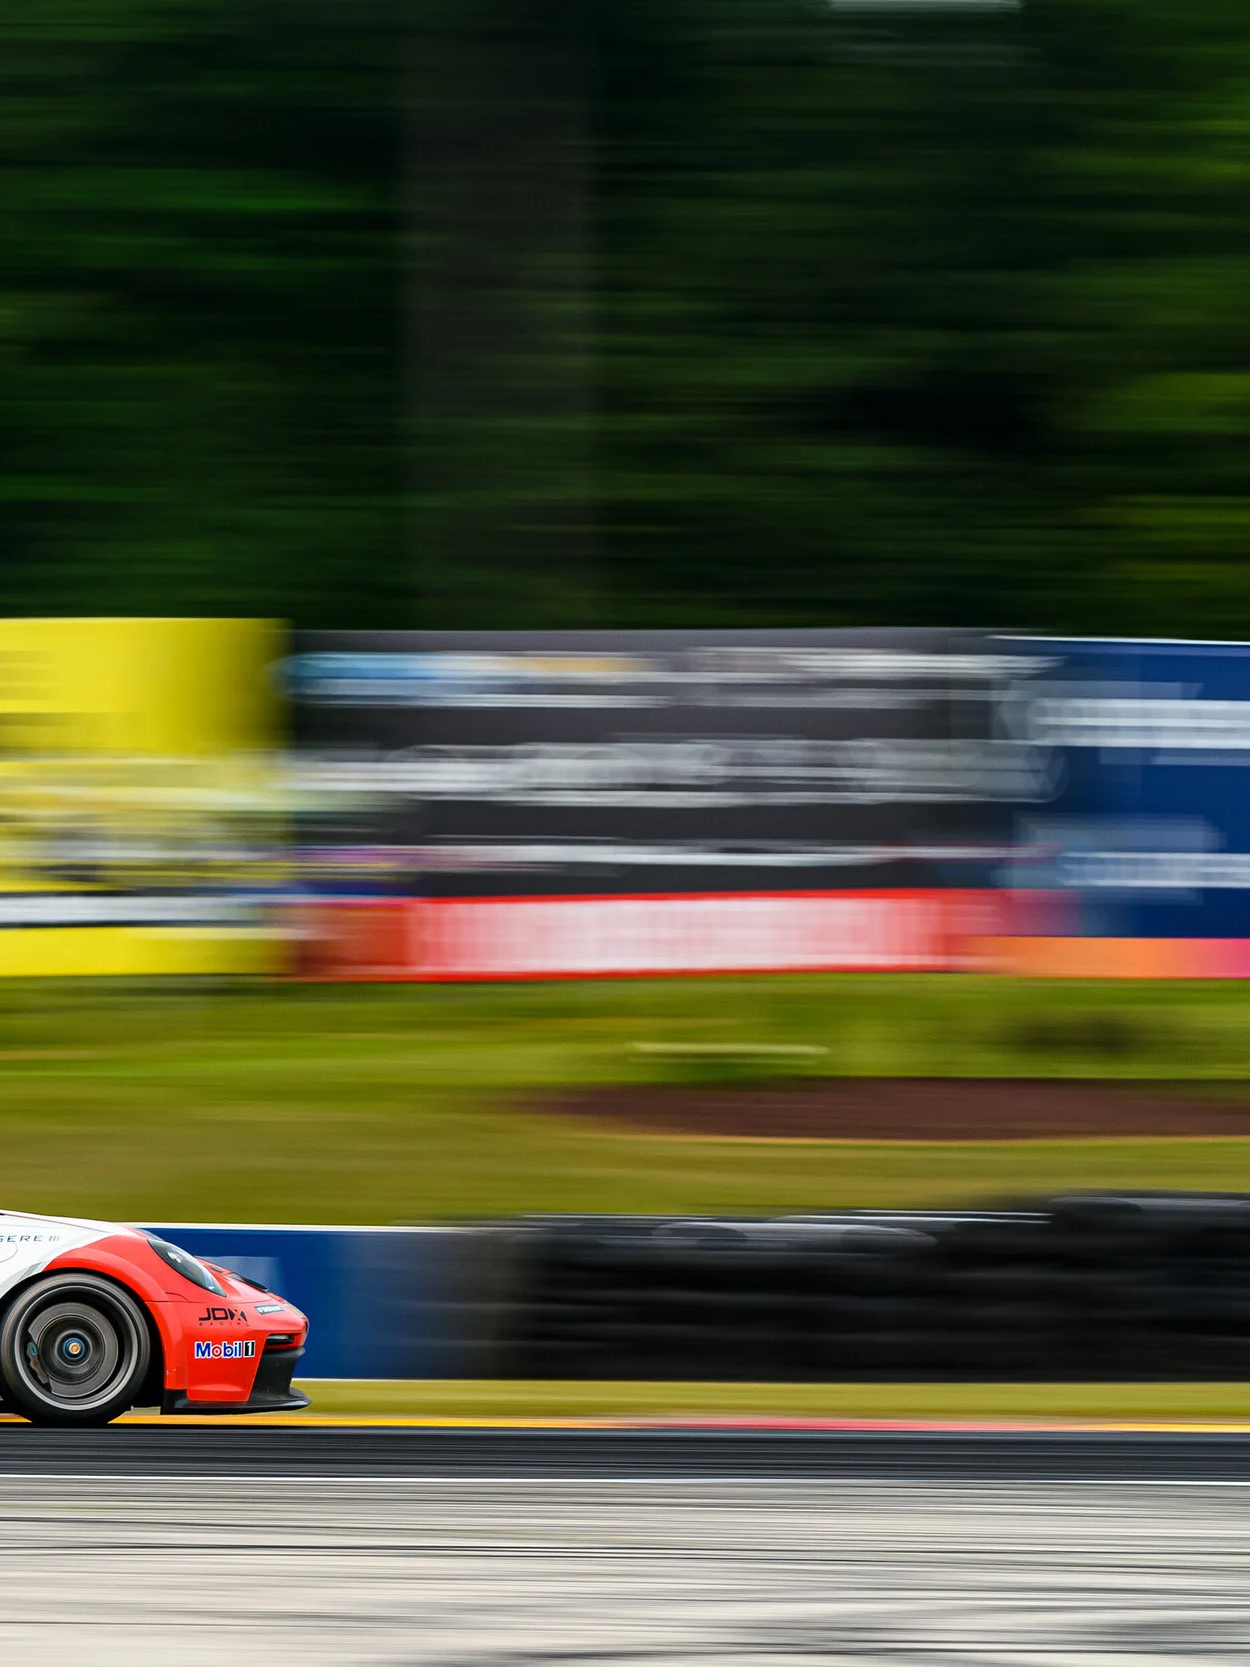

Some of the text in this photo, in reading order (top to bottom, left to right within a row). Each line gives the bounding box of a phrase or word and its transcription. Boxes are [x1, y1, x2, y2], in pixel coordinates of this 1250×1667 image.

[198, 1308, 248, 1322] JDX
[195, 1341, 255, 1358] Mobil 1
